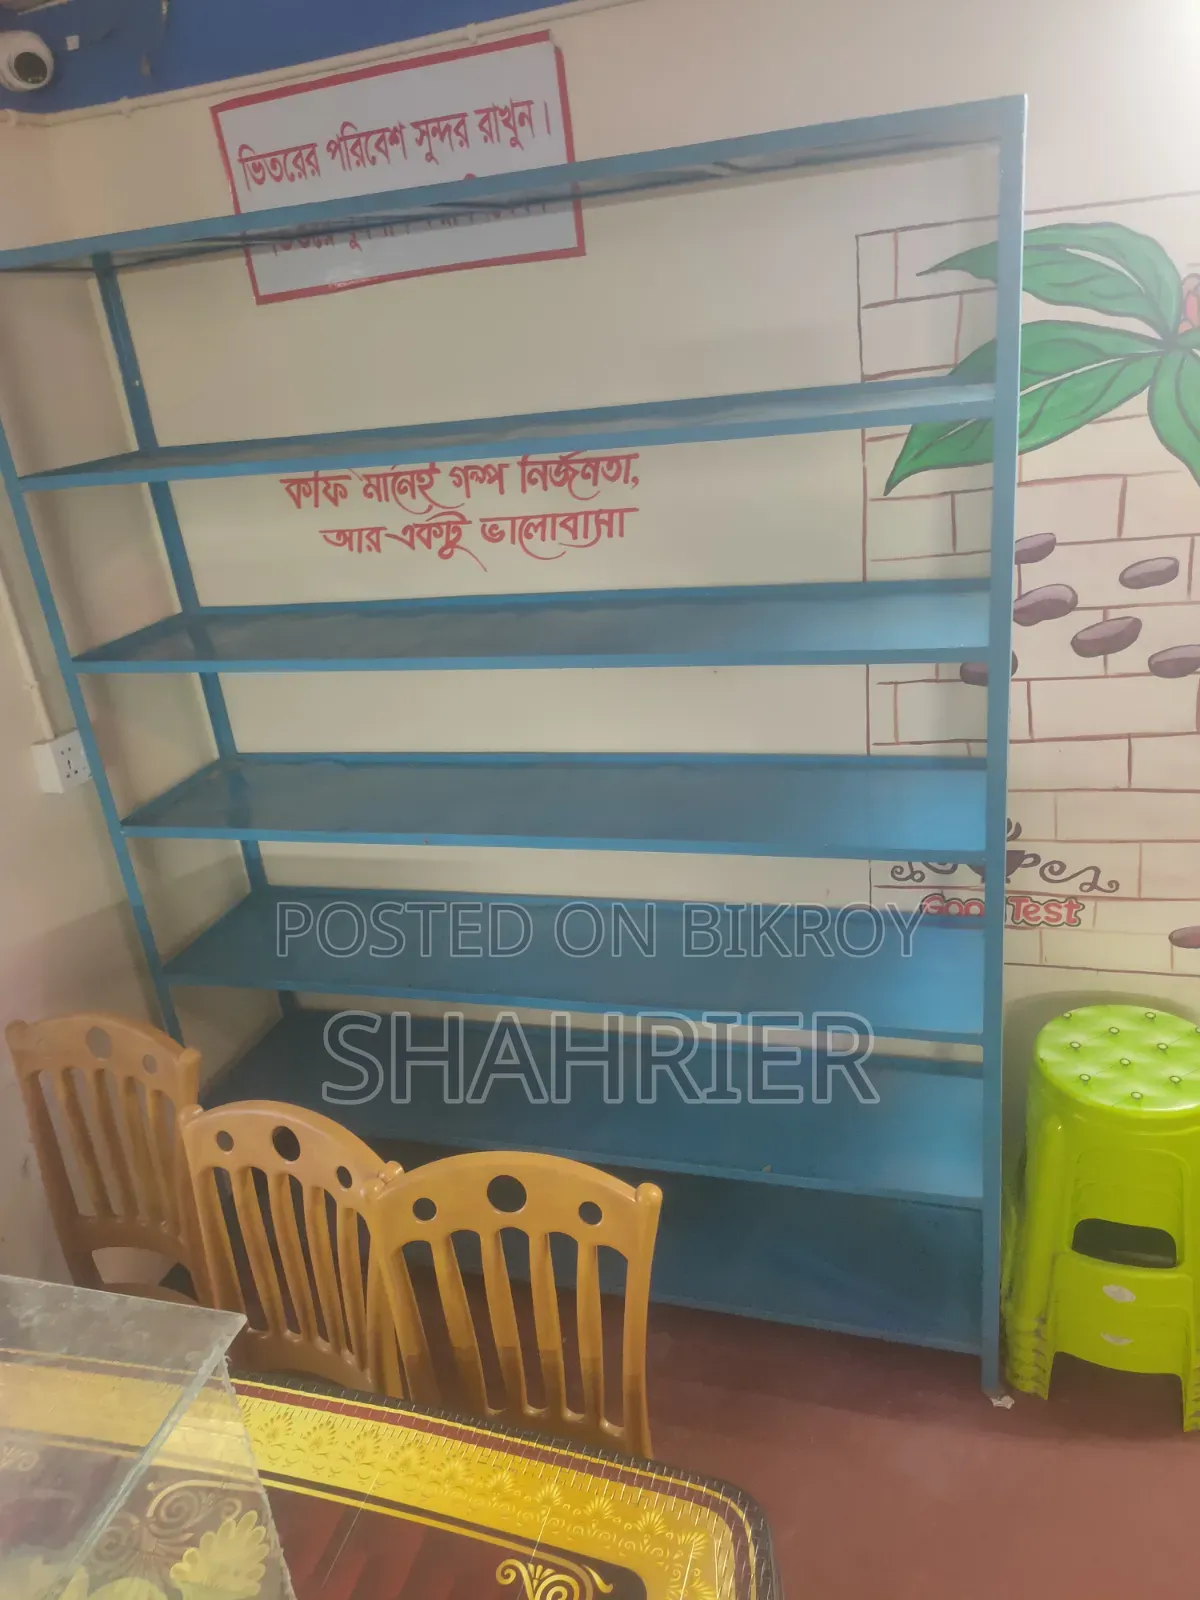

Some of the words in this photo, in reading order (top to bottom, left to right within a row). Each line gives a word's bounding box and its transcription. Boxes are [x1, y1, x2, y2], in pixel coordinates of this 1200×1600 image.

[238, 143, 321, 191] ভিতরের
[326, 121, 408, 172] পরিবেশ
[410, 111, 470, 165] সুন্দর
[361, 461, 464, 515] মানেই
[449, 464, 510, 499] গল্প
[318, 526, 388, 553] আর
[479, 507, 640, 561] ভালোবাসা
[920, 892, 986, 917] Goo
[1006, 896, 1085, 927] Test
